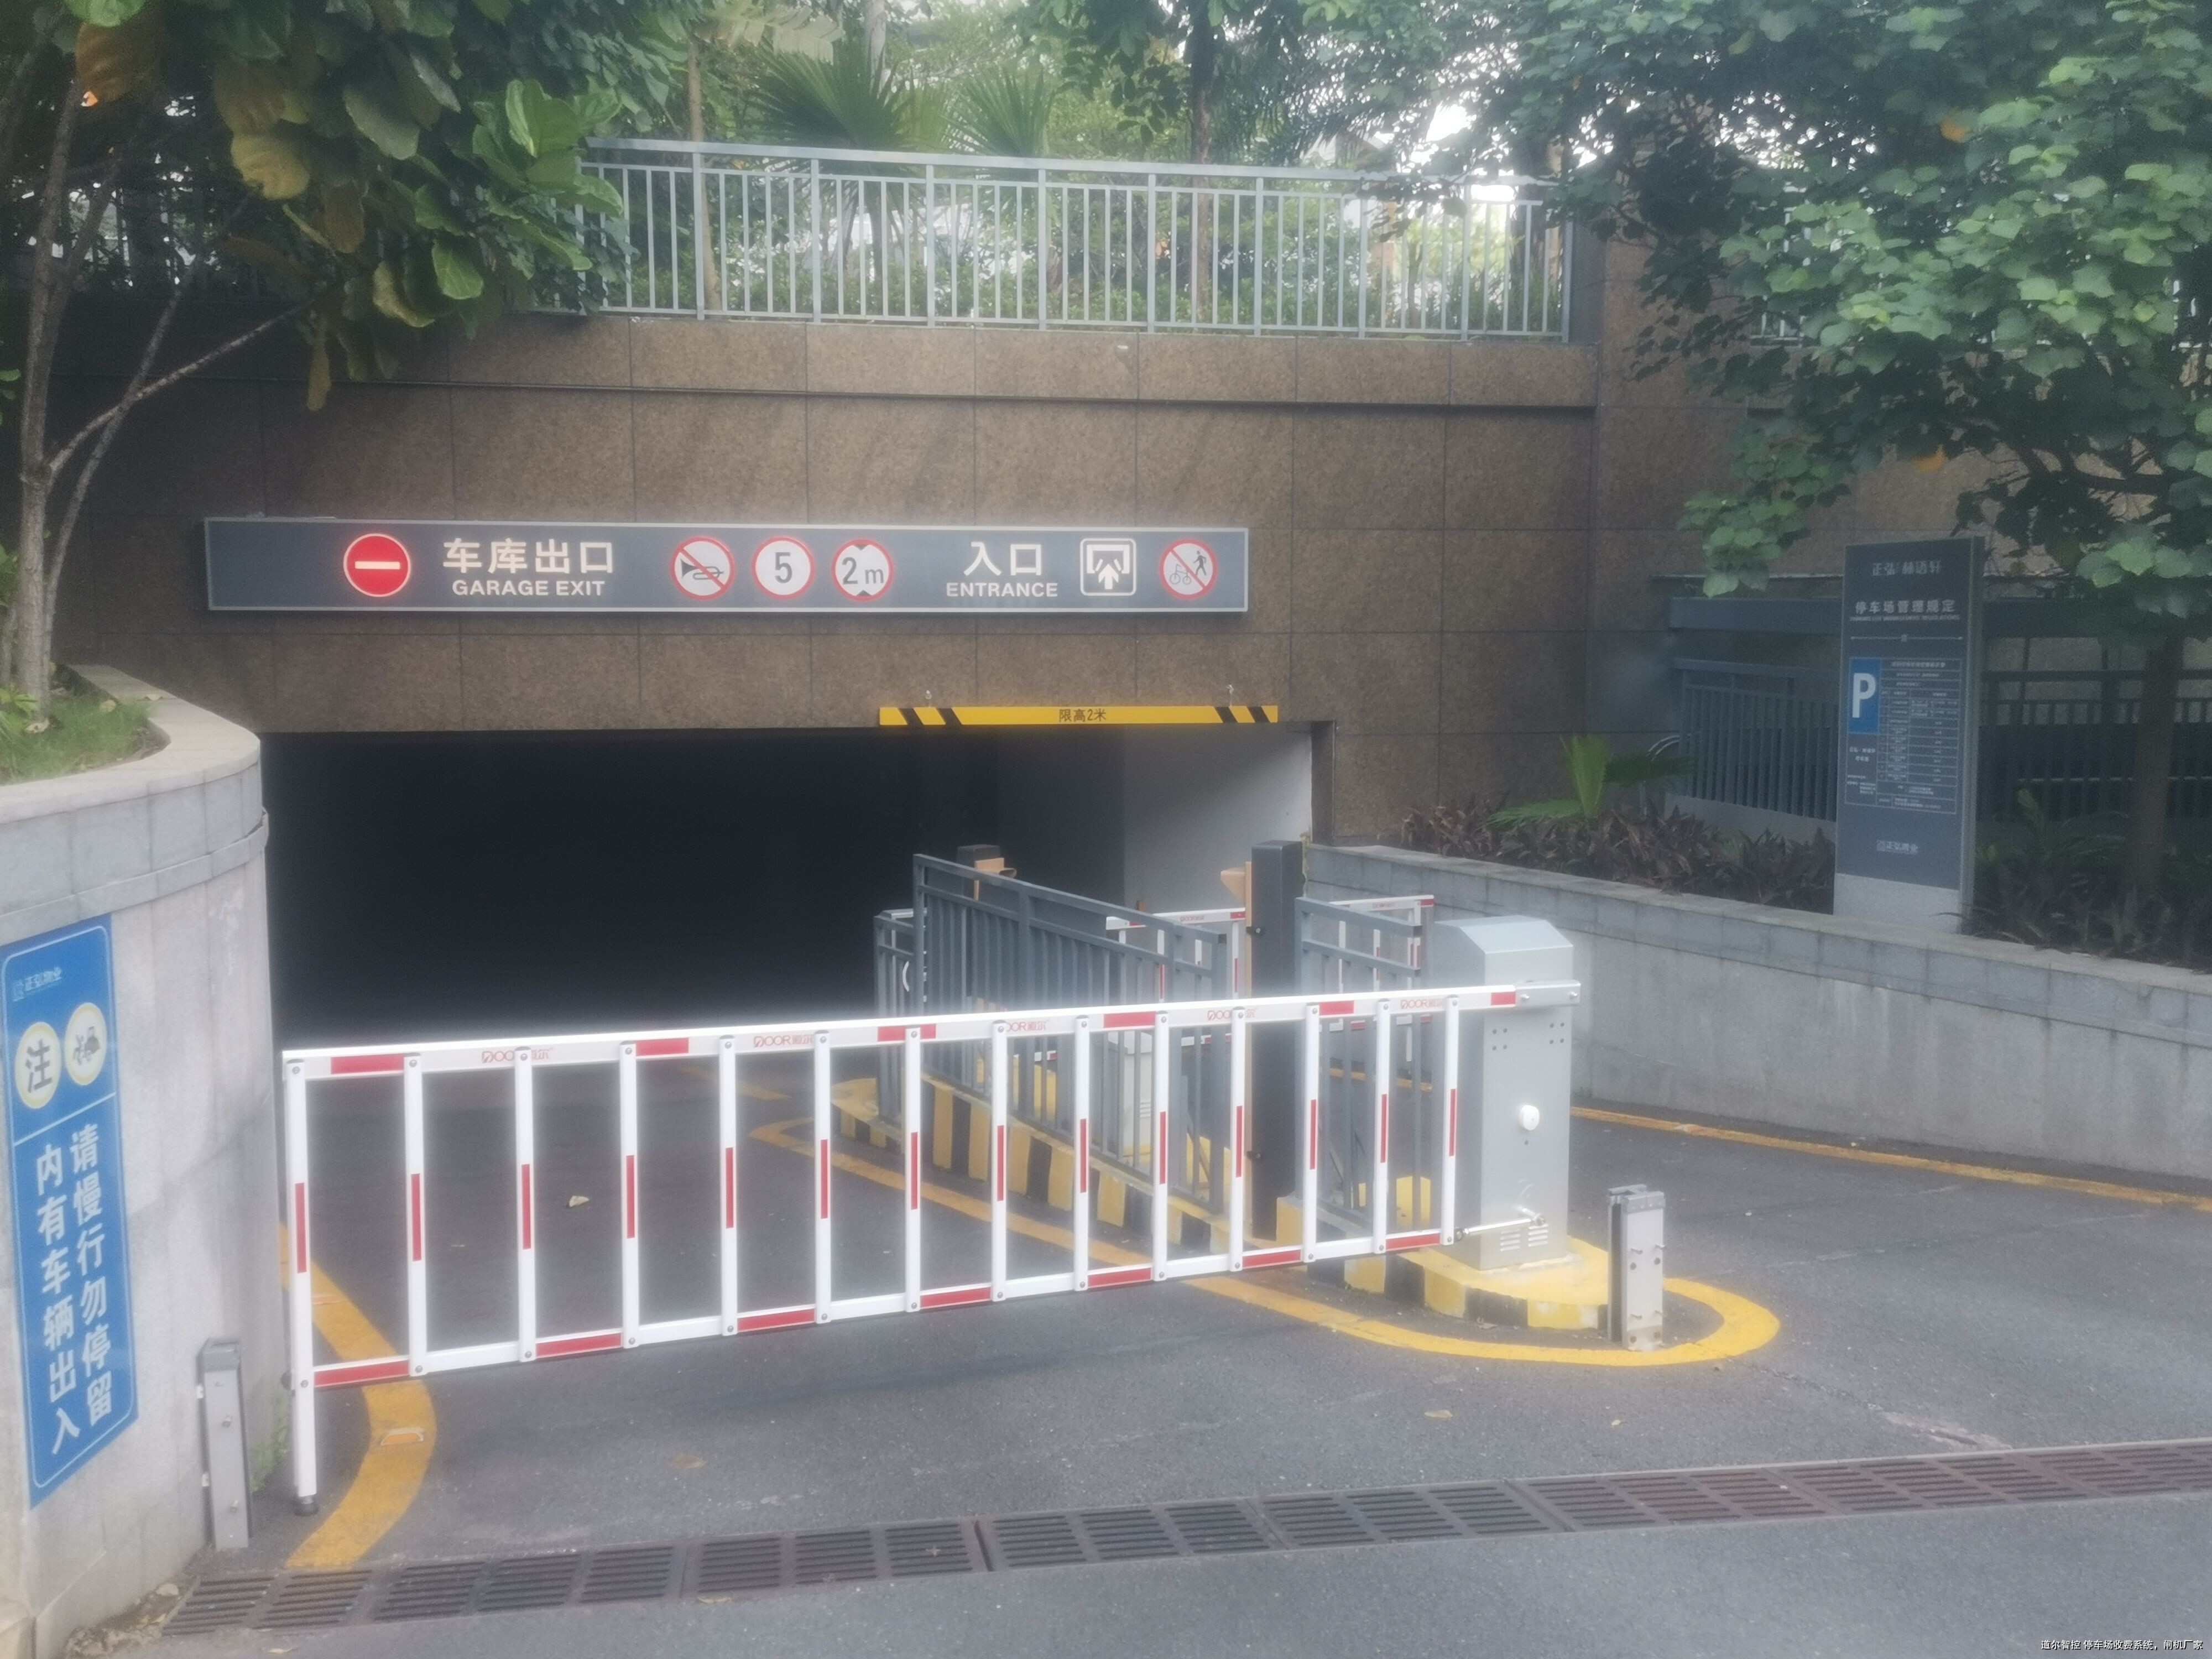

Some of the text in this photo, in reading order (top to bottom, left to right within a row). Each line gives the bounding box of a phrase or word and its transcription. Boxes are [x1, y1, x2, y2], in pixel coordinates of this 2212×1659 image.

[443, 538, 614, 575] 车库出口
[774, 552, 792, 584] 5
[963, 541, 1043, 576] 入口
[452, 580, 604, 596] GARAGE EXIT
[946, 582, 1058, 598] ENTRANCE
[1855, 599, 1955, 614] 停车场管理规定
[1852, 672, 1876, 718] P
[1058, 708, 1107, 723] 限高2米
[1207, 1009, 1233, 1021] DOO
[25, 1039, 53, 1094] 注
[481, 1050, 515, 1063] DOO
[70, 1123, 113, 1427] 请慢行勿停留
[36, 1143, 81, 1455] 内有车辆出入
